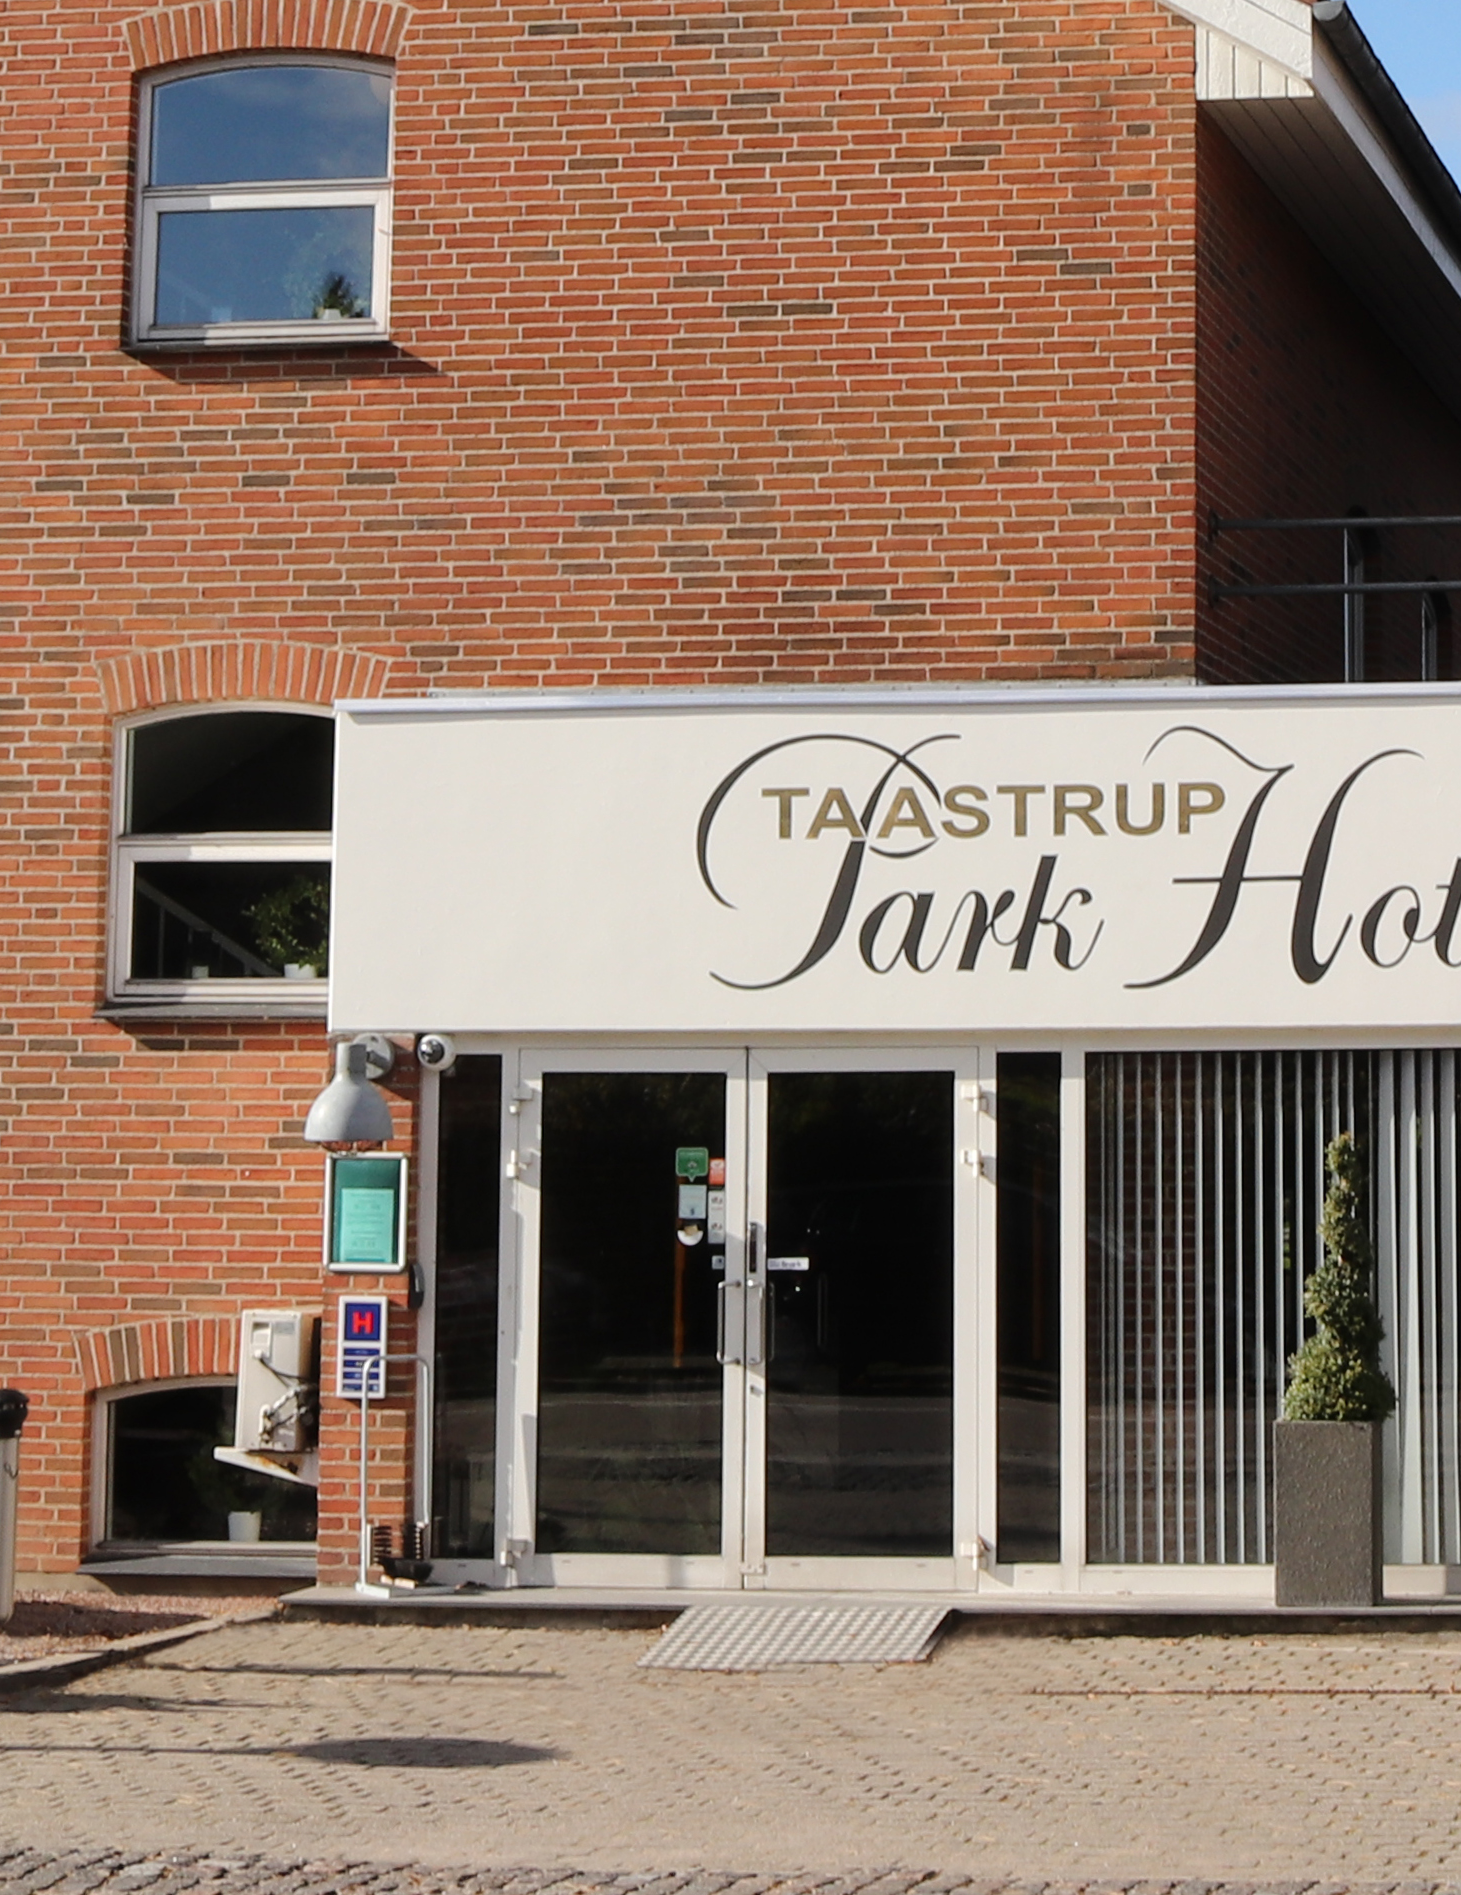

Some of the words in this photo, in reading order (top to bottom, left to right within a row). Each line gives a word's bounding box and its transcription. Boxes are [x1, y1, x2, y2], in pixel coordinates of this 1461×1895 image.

[762, 784, 1225, 840] TAASTRUP
[696, 734, 1105, 991] Park
[352, 1311, 374, 1334] H
